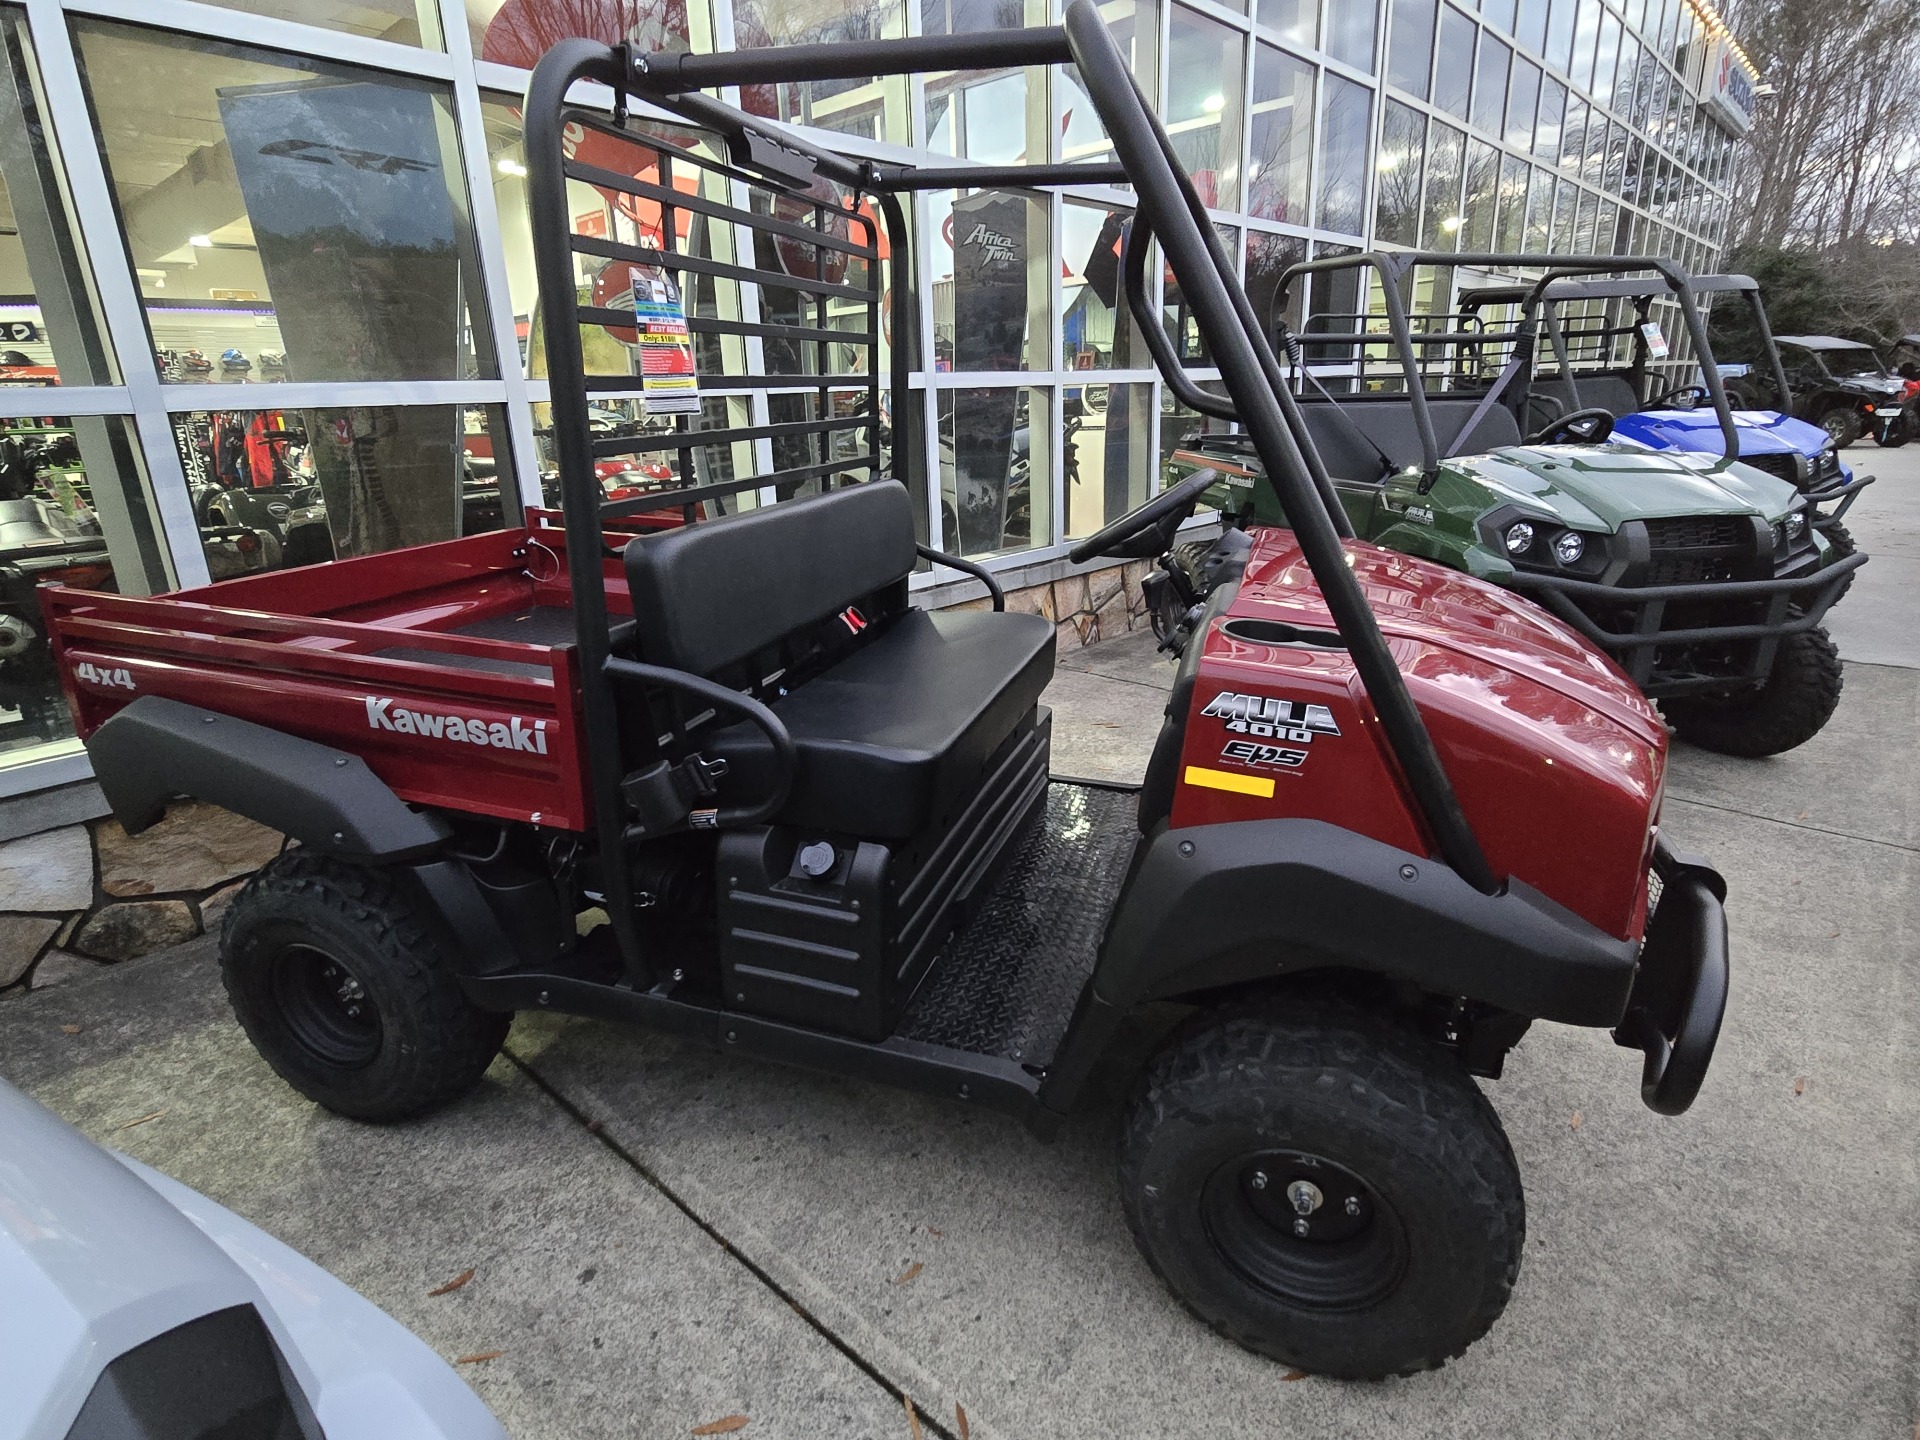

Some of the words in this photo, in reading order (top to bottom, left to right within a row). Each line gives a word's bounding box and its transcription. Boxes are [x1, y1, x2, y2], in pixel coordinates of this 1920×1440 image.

[961, 223, 1019, 249] Africa
[981, 244, 1021, 268] Twin
[643, 335, 660, 344] Only:
[649, 325, 666, 333] BEST
[1224, 473, 1256, 489] Kawasaki
[78, 662, 137, 691] 4x4
[365, 696, 548, 755] Kawasaki
[1200, 691, 1342, 737] MULE
[1225, 720, 1313, 744] 4010
